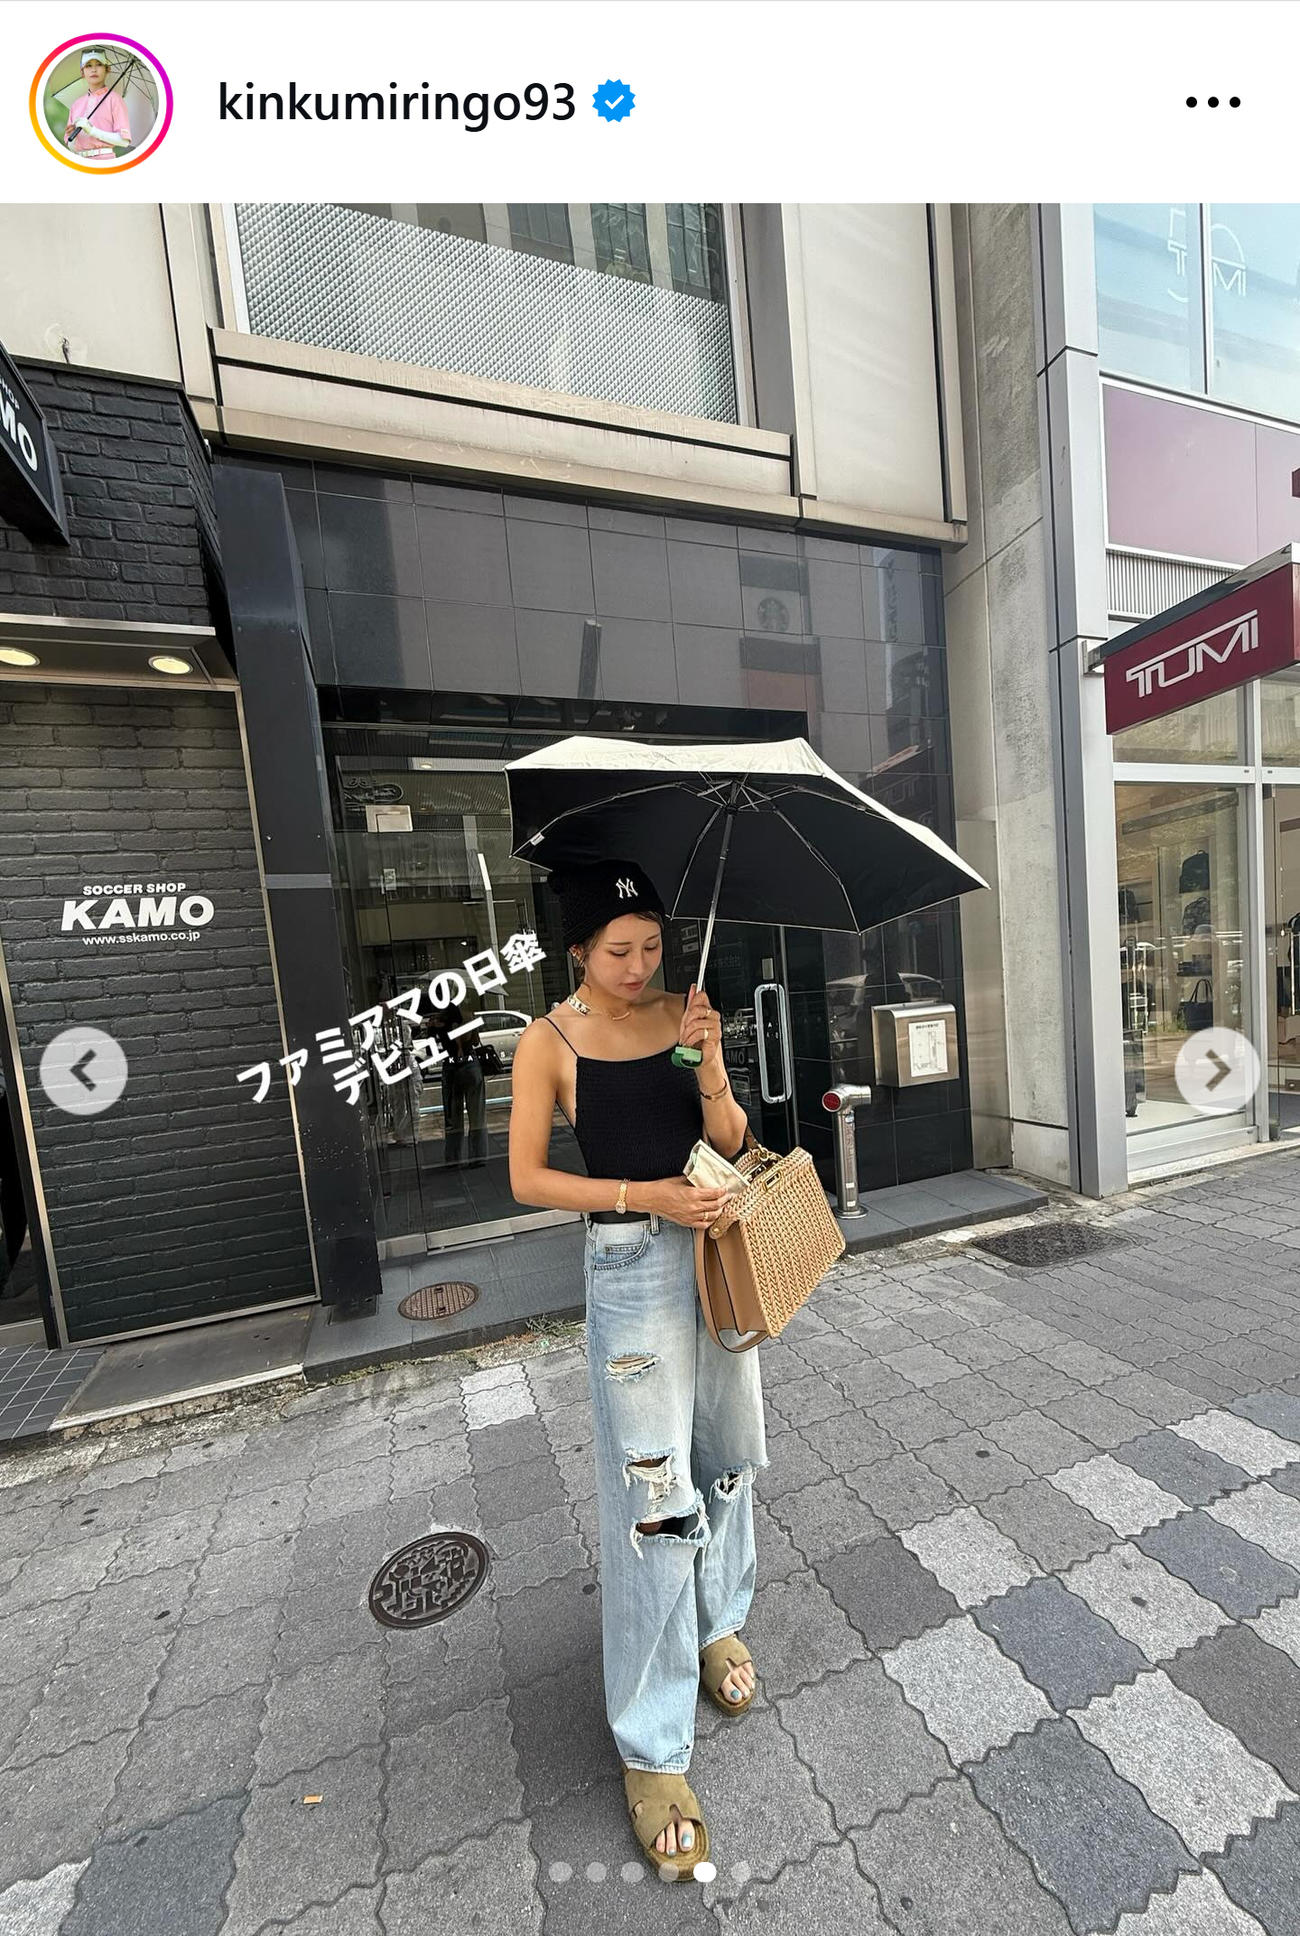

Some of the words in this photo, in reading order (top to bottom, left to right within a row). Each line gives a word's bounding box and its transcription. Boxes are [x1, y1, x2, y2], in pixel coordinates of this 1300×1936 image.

[1126, 608, 1259, 698] TUMI
[82, 884, 143, 896] SOCCER
[146, 882, 187, 894] SHOP
[615, 877, 639, 899] NY
[60, 895, 215, 932] KAMO
[82, 930, 201, 946] www.sskamo.co.jp
